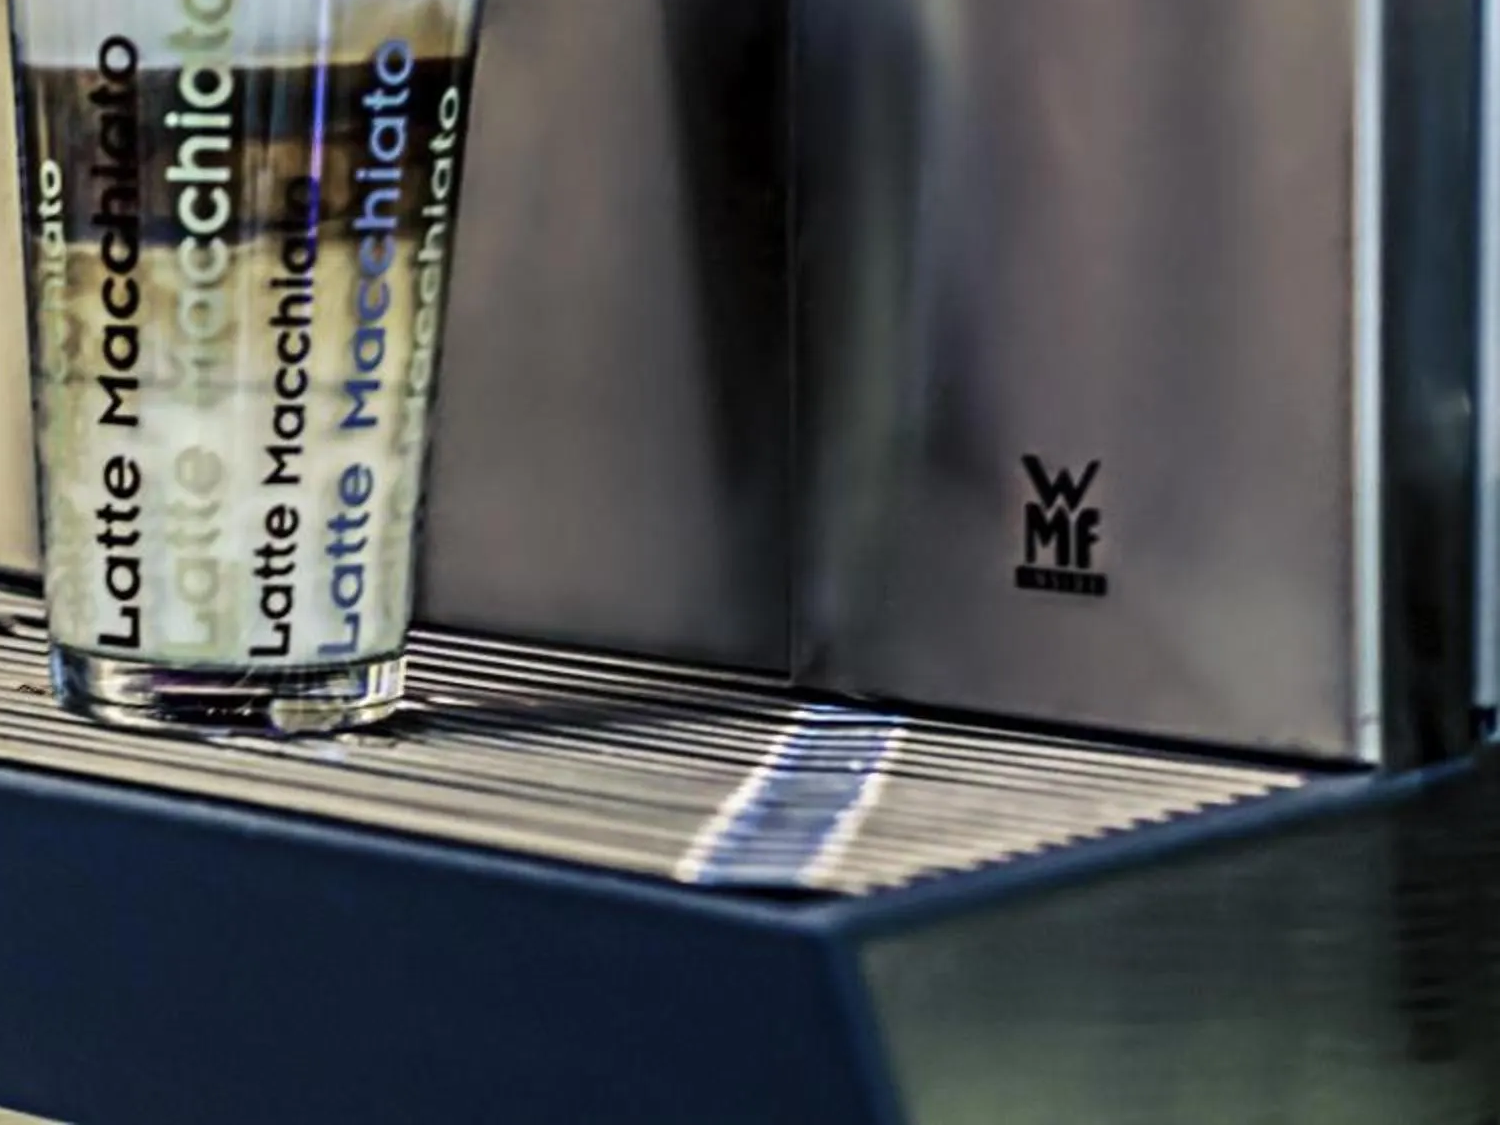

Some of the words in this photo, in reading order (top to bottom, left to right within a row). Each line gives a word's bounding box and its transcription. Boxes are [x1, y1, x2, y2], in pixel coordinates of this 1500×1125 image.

[89, 35, 139, 427] Macchiato
[339, 39, 414, 430] Macchiato
[96, 455, 141, 649] Latte
[164, 445, 223, 657] Latte
[249, 504, 300, 657] Latte
[317, 463, 374, 655] Latte
[1021, 452, 1101, 569] WMF
